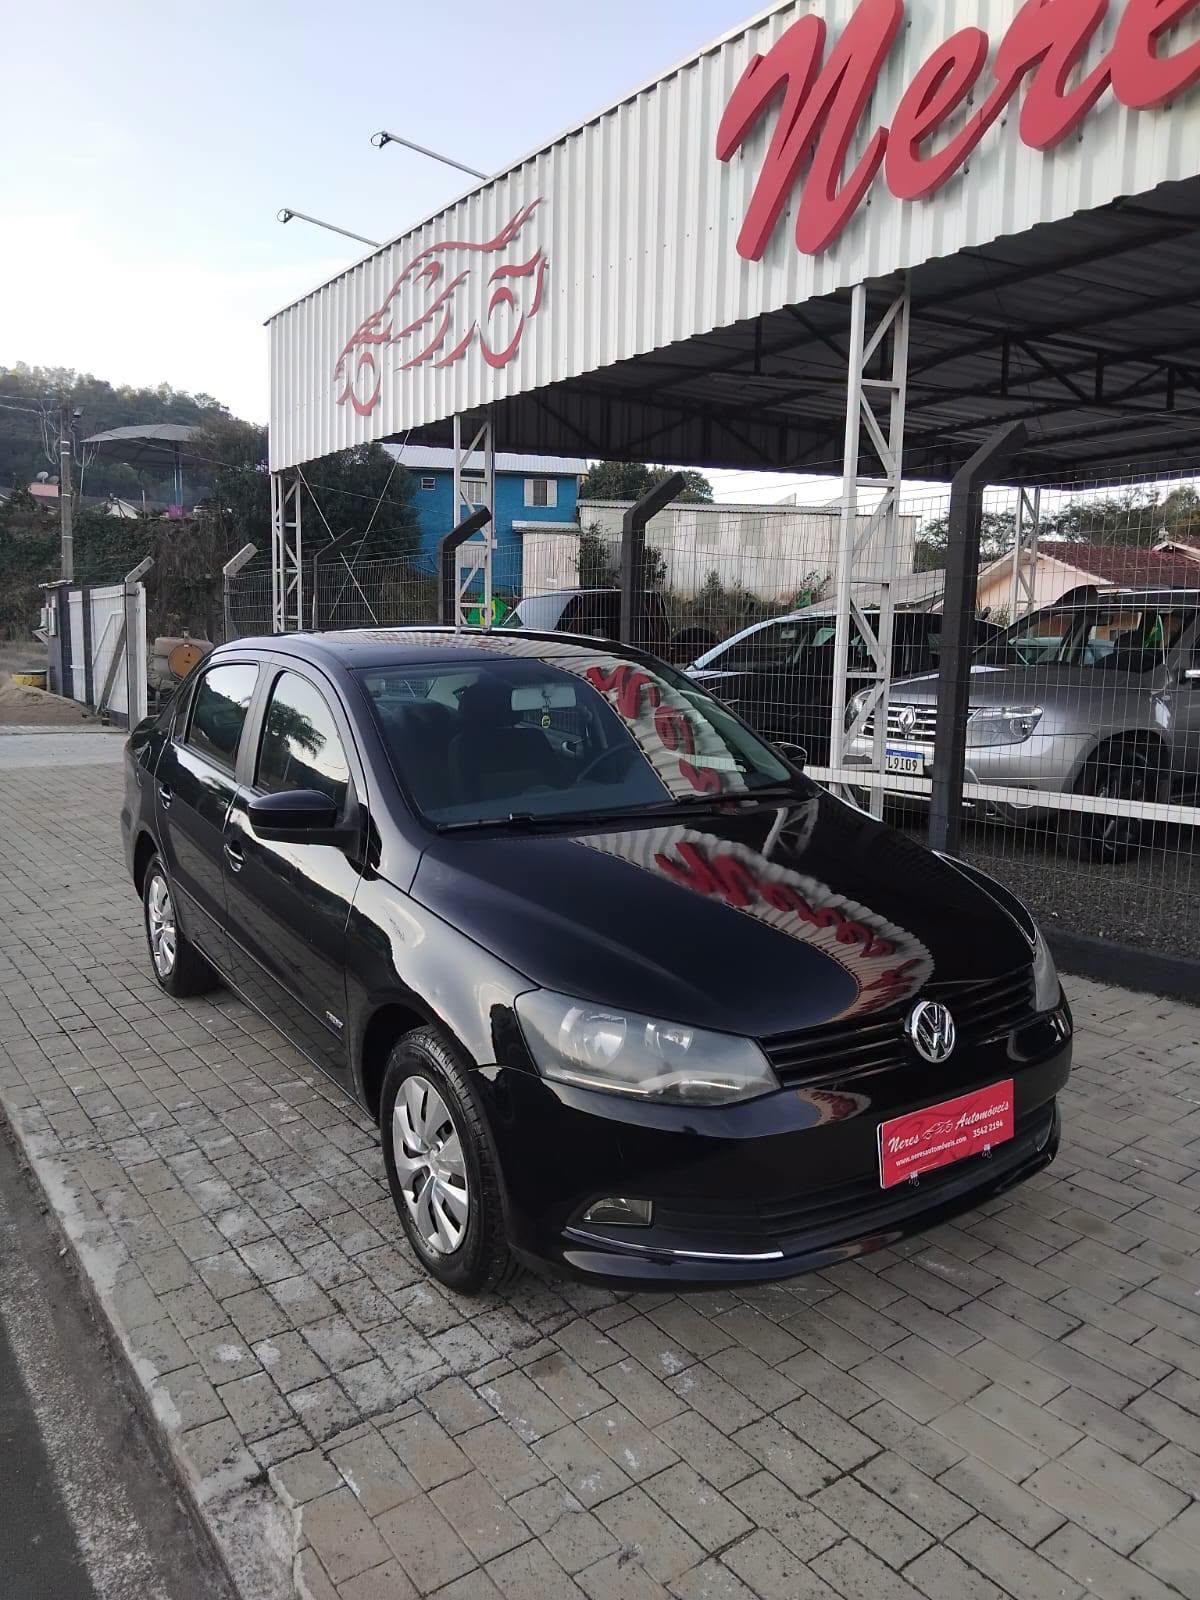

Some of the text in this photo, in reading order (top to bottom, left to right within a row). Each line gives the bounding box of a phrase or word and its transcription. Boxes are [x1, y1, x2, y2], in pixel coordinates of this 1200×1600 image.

[885, 756, 918, 772] L9I09
[887, 1101, 1009, 1153] Neres Automóveis
